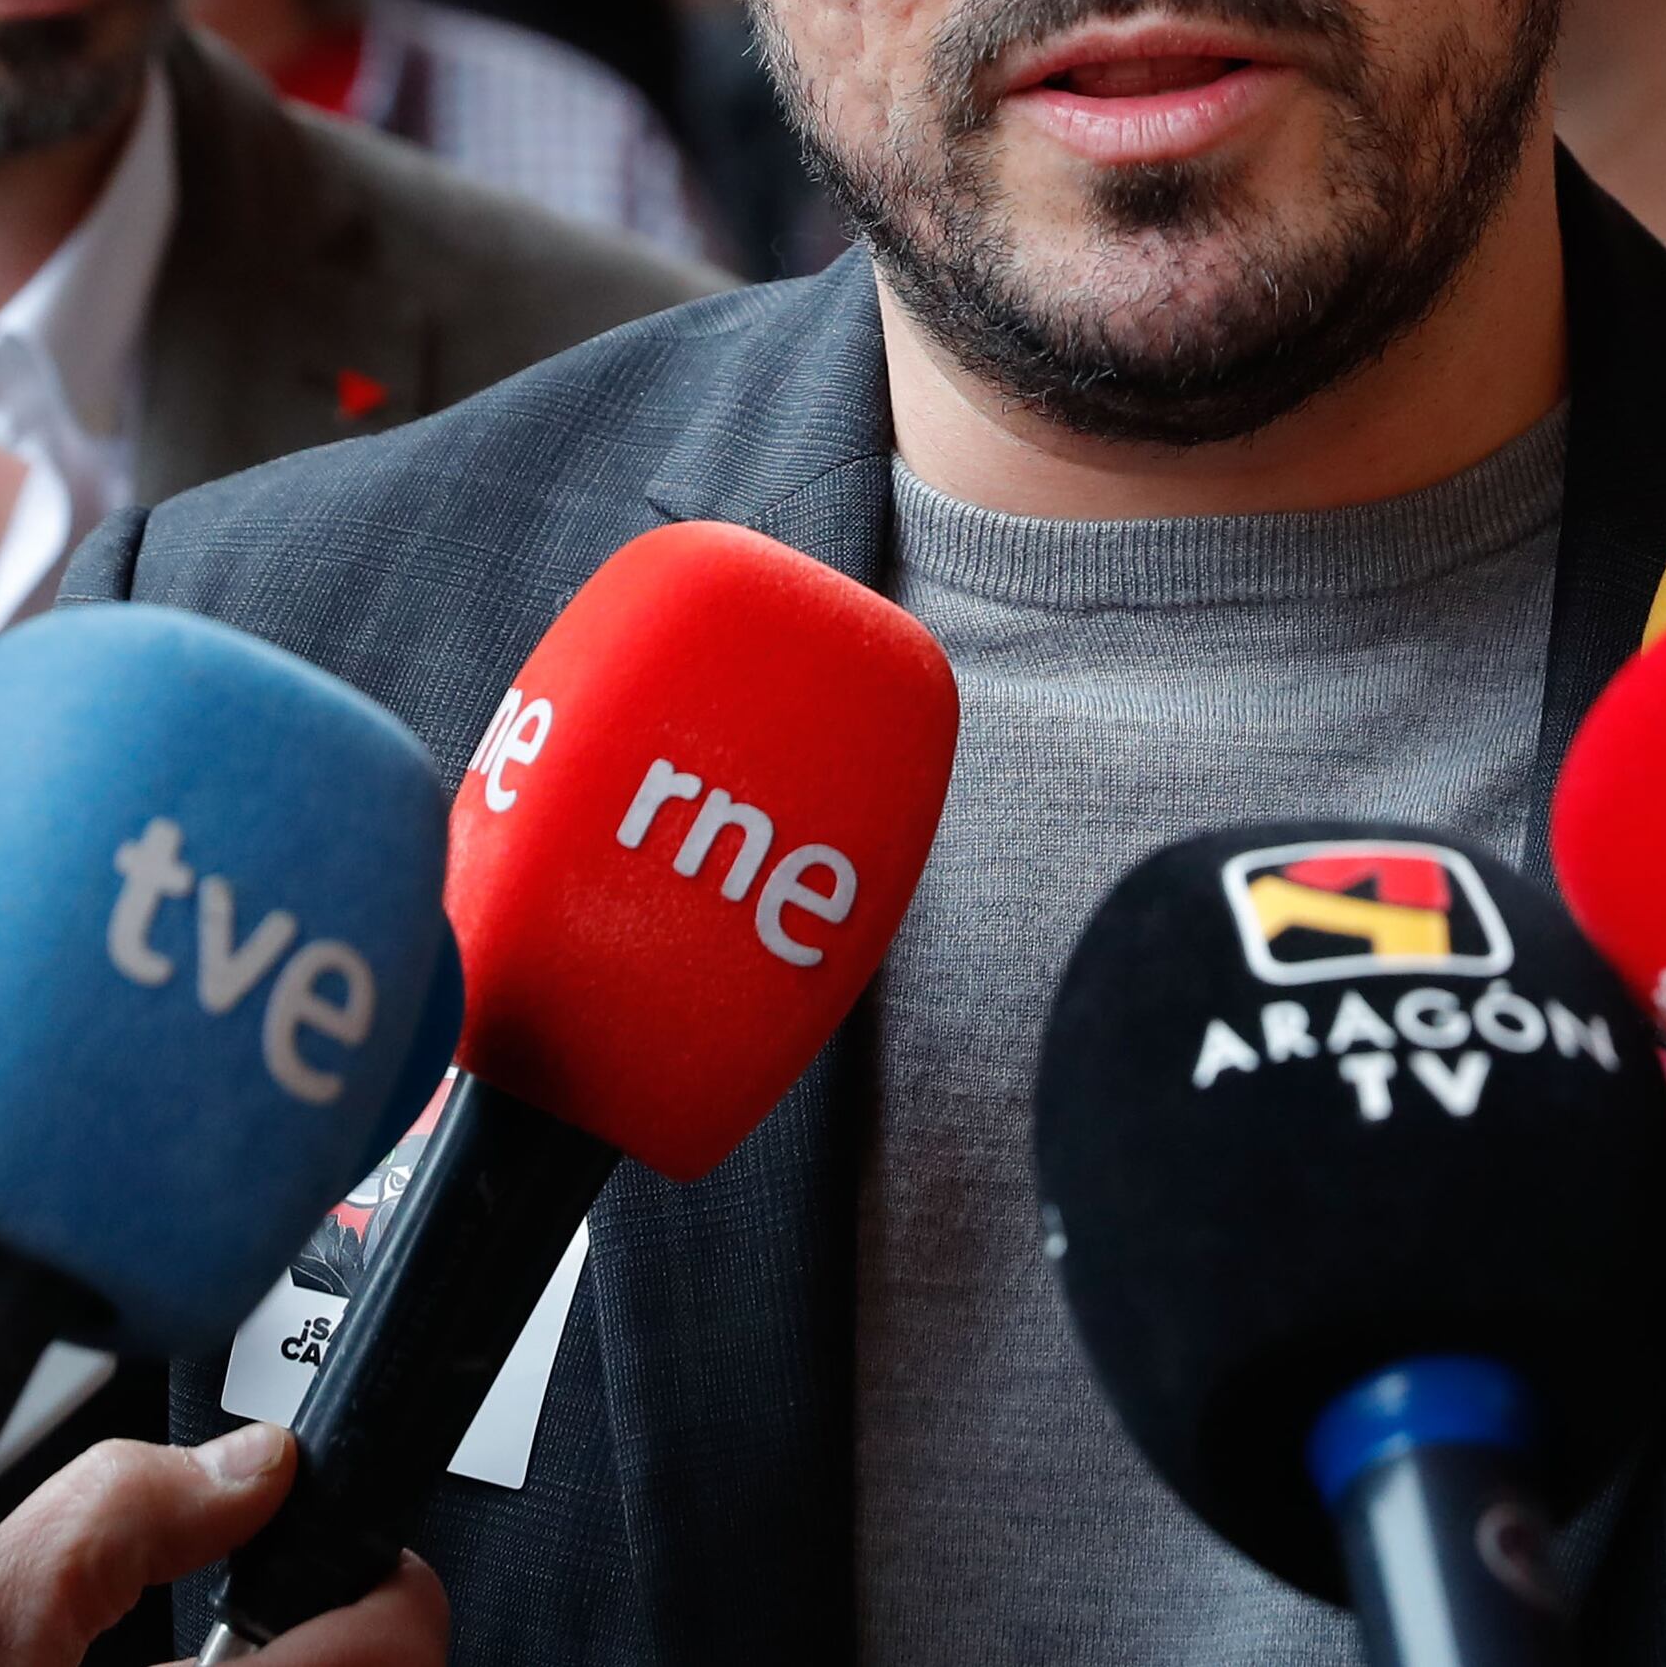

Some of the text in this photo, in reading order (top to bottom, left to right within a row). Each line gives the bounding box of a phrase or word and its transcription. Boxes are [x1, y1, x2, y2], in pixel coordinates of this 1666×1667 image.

[616, 758, 858, 967] rne
[106, 816, 376, 1106] tve
[1192, 978, 1621, 1090] ARAGÓN
[1337, 1049, 1493, 1123] TV
